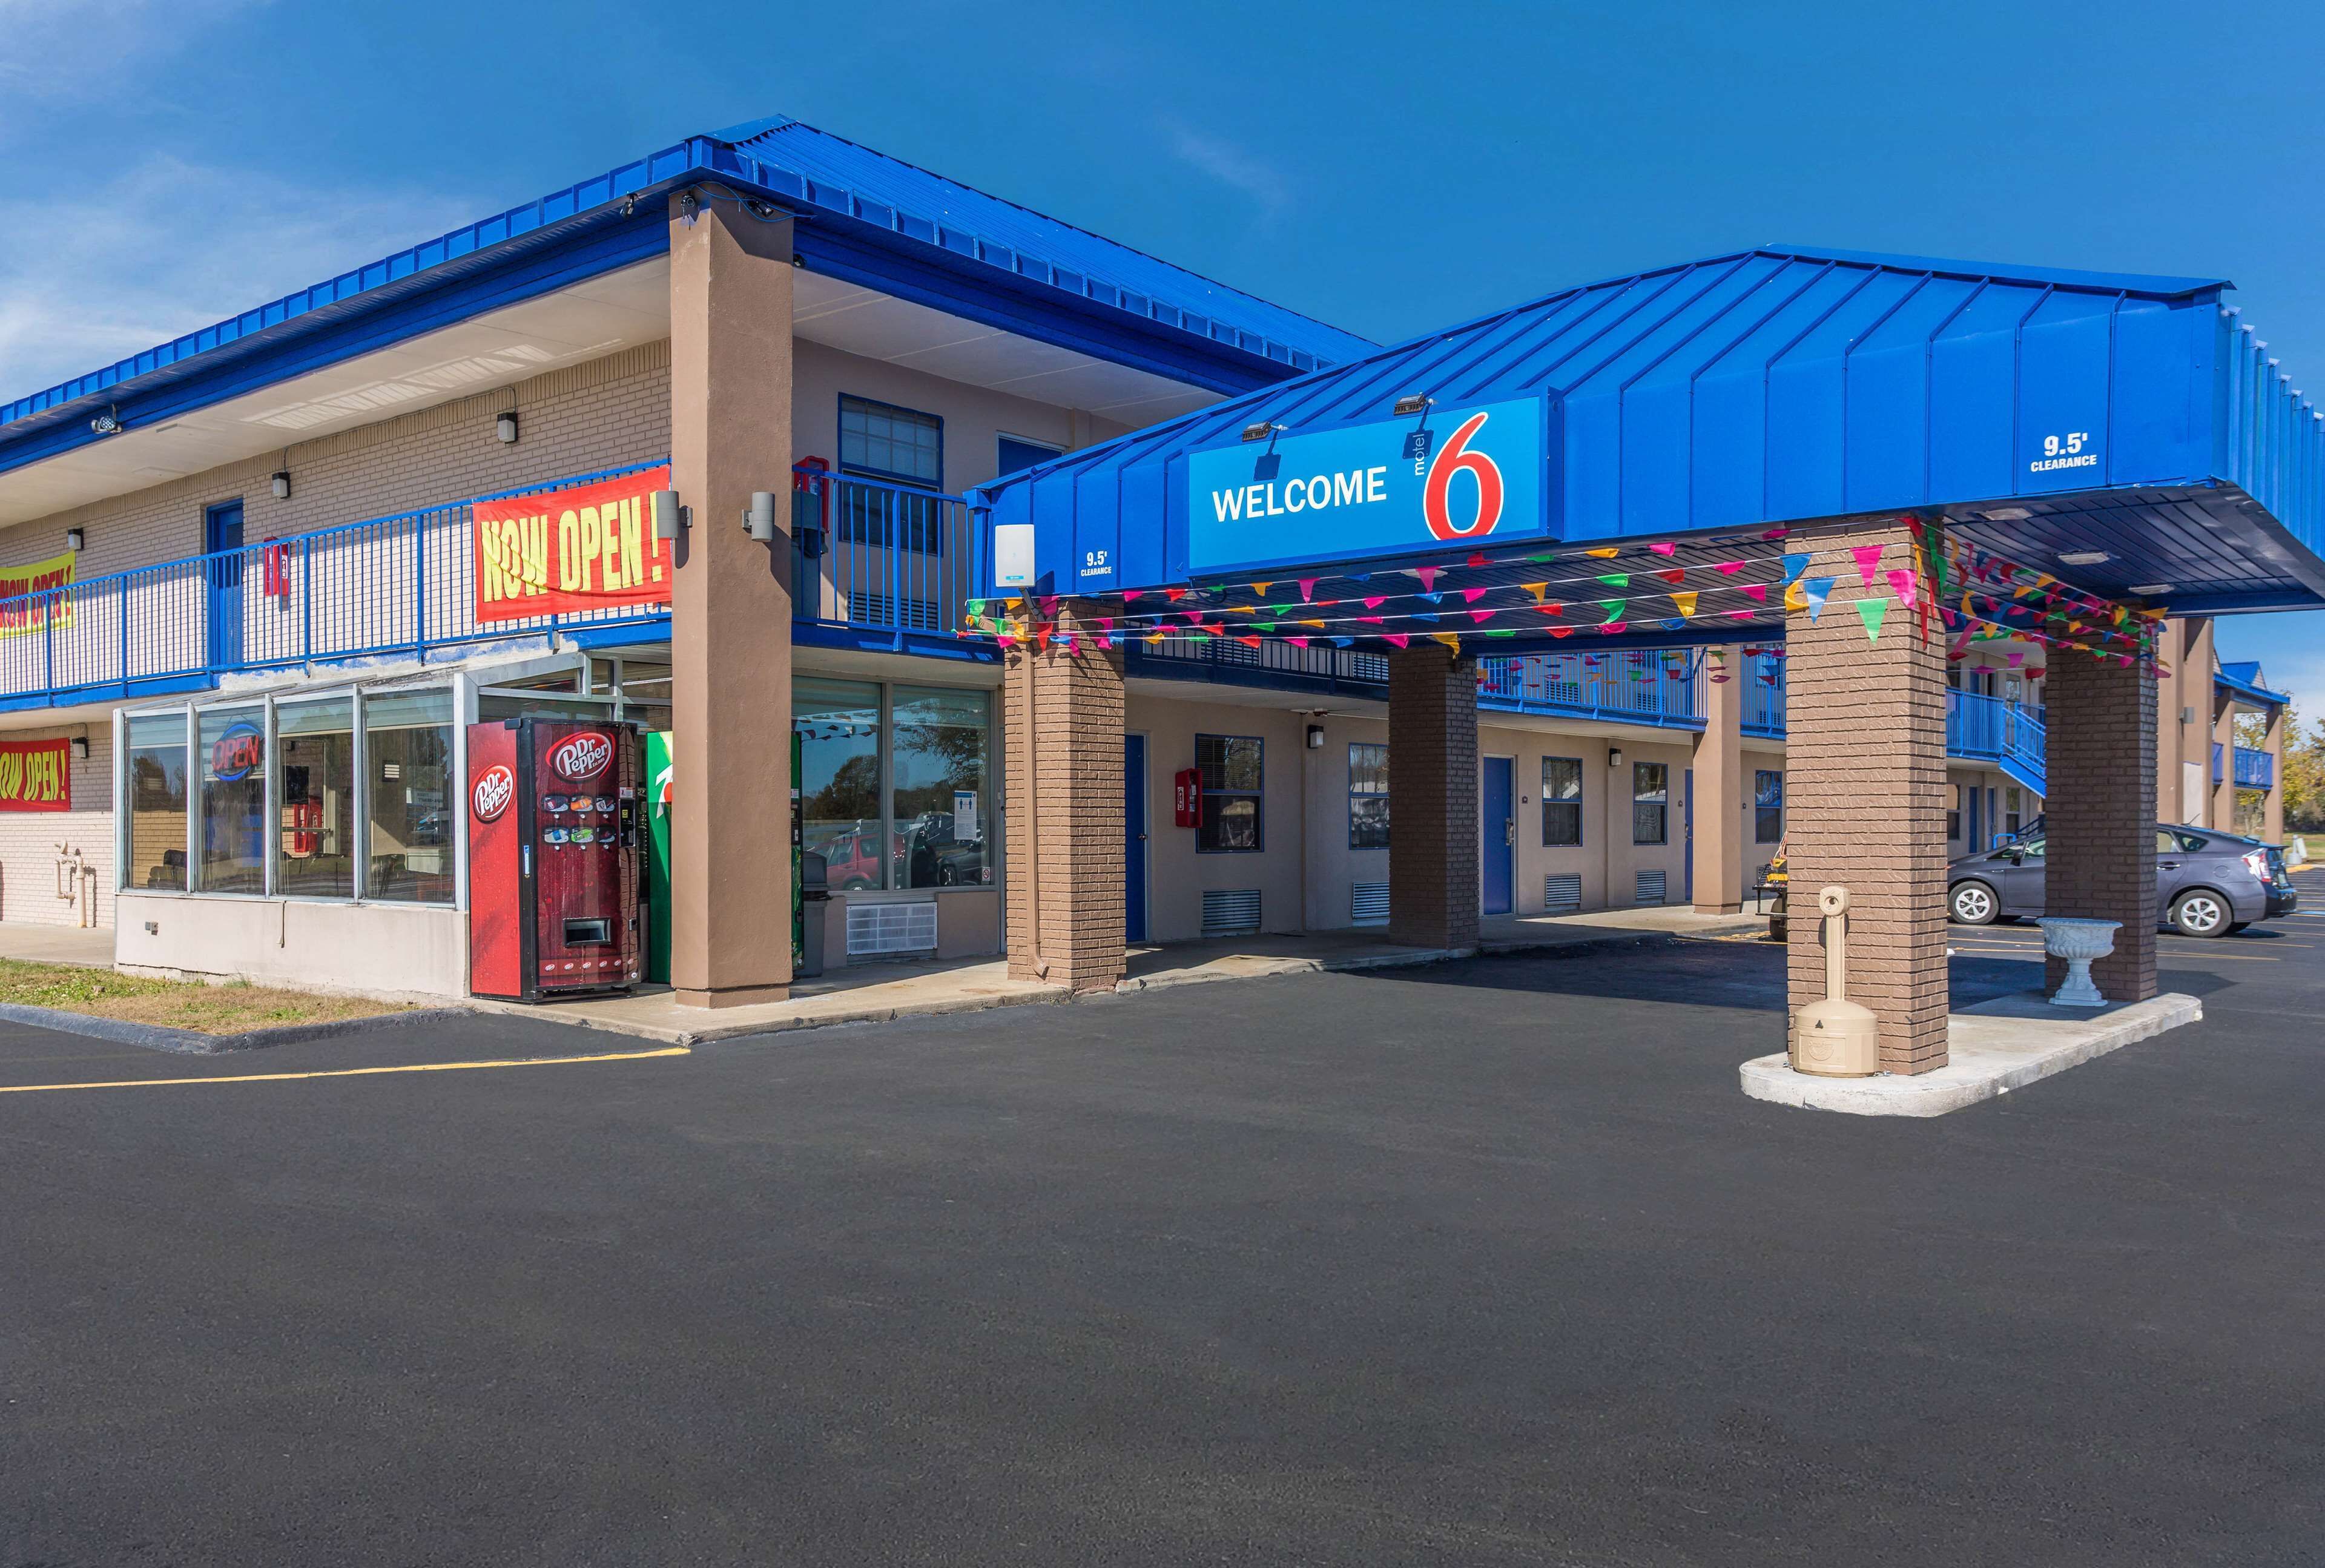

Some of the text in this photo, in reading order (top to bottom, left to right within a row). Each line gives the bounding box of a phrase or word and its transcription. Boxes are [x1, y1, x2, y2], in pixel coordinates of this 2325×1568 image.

[1413, 411, 1504, 540] motel 6
[2031, 455, 2097, 472] CLEARANCE
[1212, 466, 1387, 522] WELCOME
[481, 514, 548, 602] NOW
[1081, 566, 1112, 576] CLEARANCE
[212, 734, 259, 771] OPEN
[556, 743, 607, 776] Pepper
[576, 739, 596, 758] Dr
[0, 752, 23, 799] OW
[486, 772, 501, 794] Dr
[475, 777, 509, 815] Pepper
